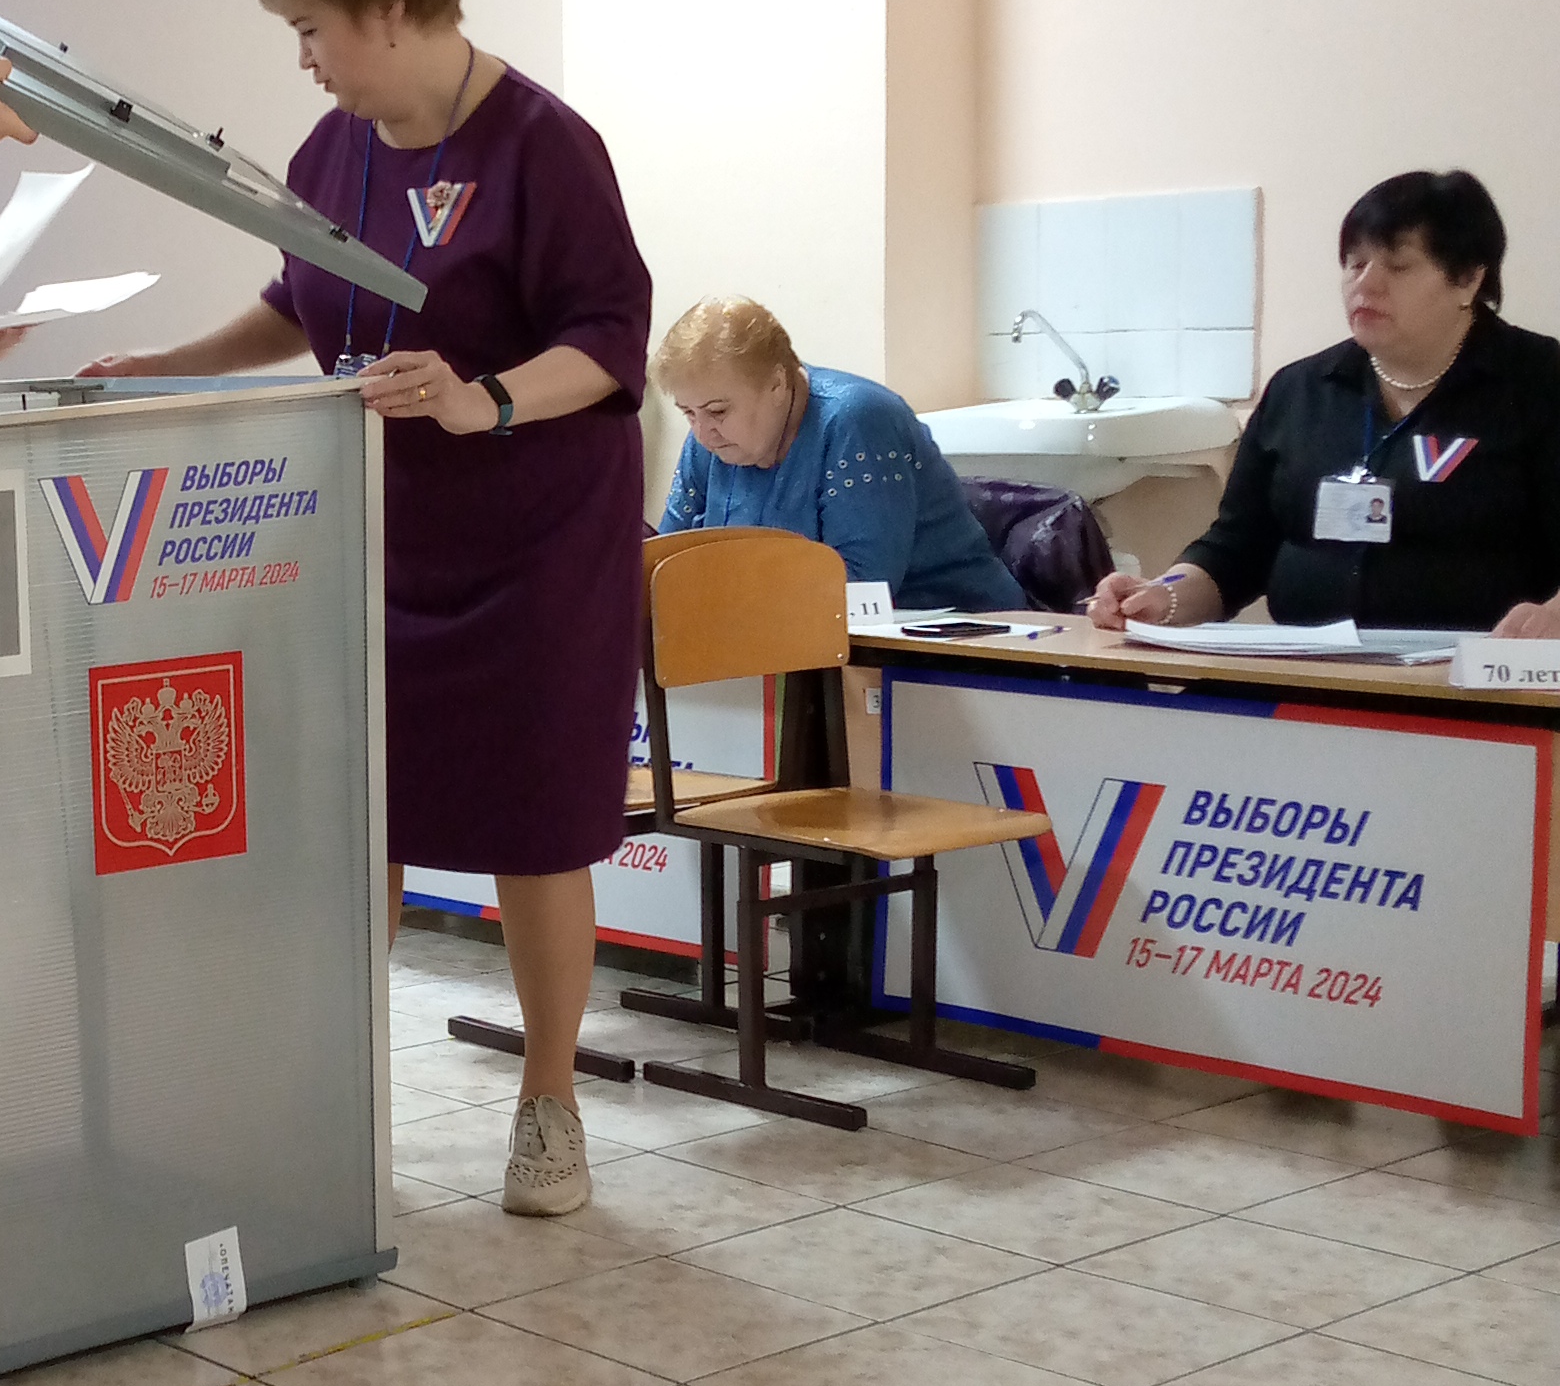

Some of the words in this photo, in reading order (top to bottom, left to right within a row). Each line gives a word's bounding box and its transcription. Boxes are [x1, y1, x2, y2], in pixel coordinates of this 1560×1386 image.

[180, 457, 288, 491] ВЫБОРЫ
[169, 489, 318, 529] ПРЕЗИДЕНТА
[158, 531, 256, 566] РОССИИ
[199, 566, 257, 593] МАРТА
[259, 561, 300, 586] 2024
[861, 602, 880, 615] 11
[1483, 664, 1511, 683] 70
[1183, 790, 1372, 847] ВЫБОРЫ
[618, 842, 668, 872] 2024
[1161, 840, 1425, 911] ПРЕЗИДЕНТА
[1141, 889, 1307, 947] РОССИИ
[1204, 950, 1304, 995] МАРТА
[1307, 967, 1383, 1008] 2024
